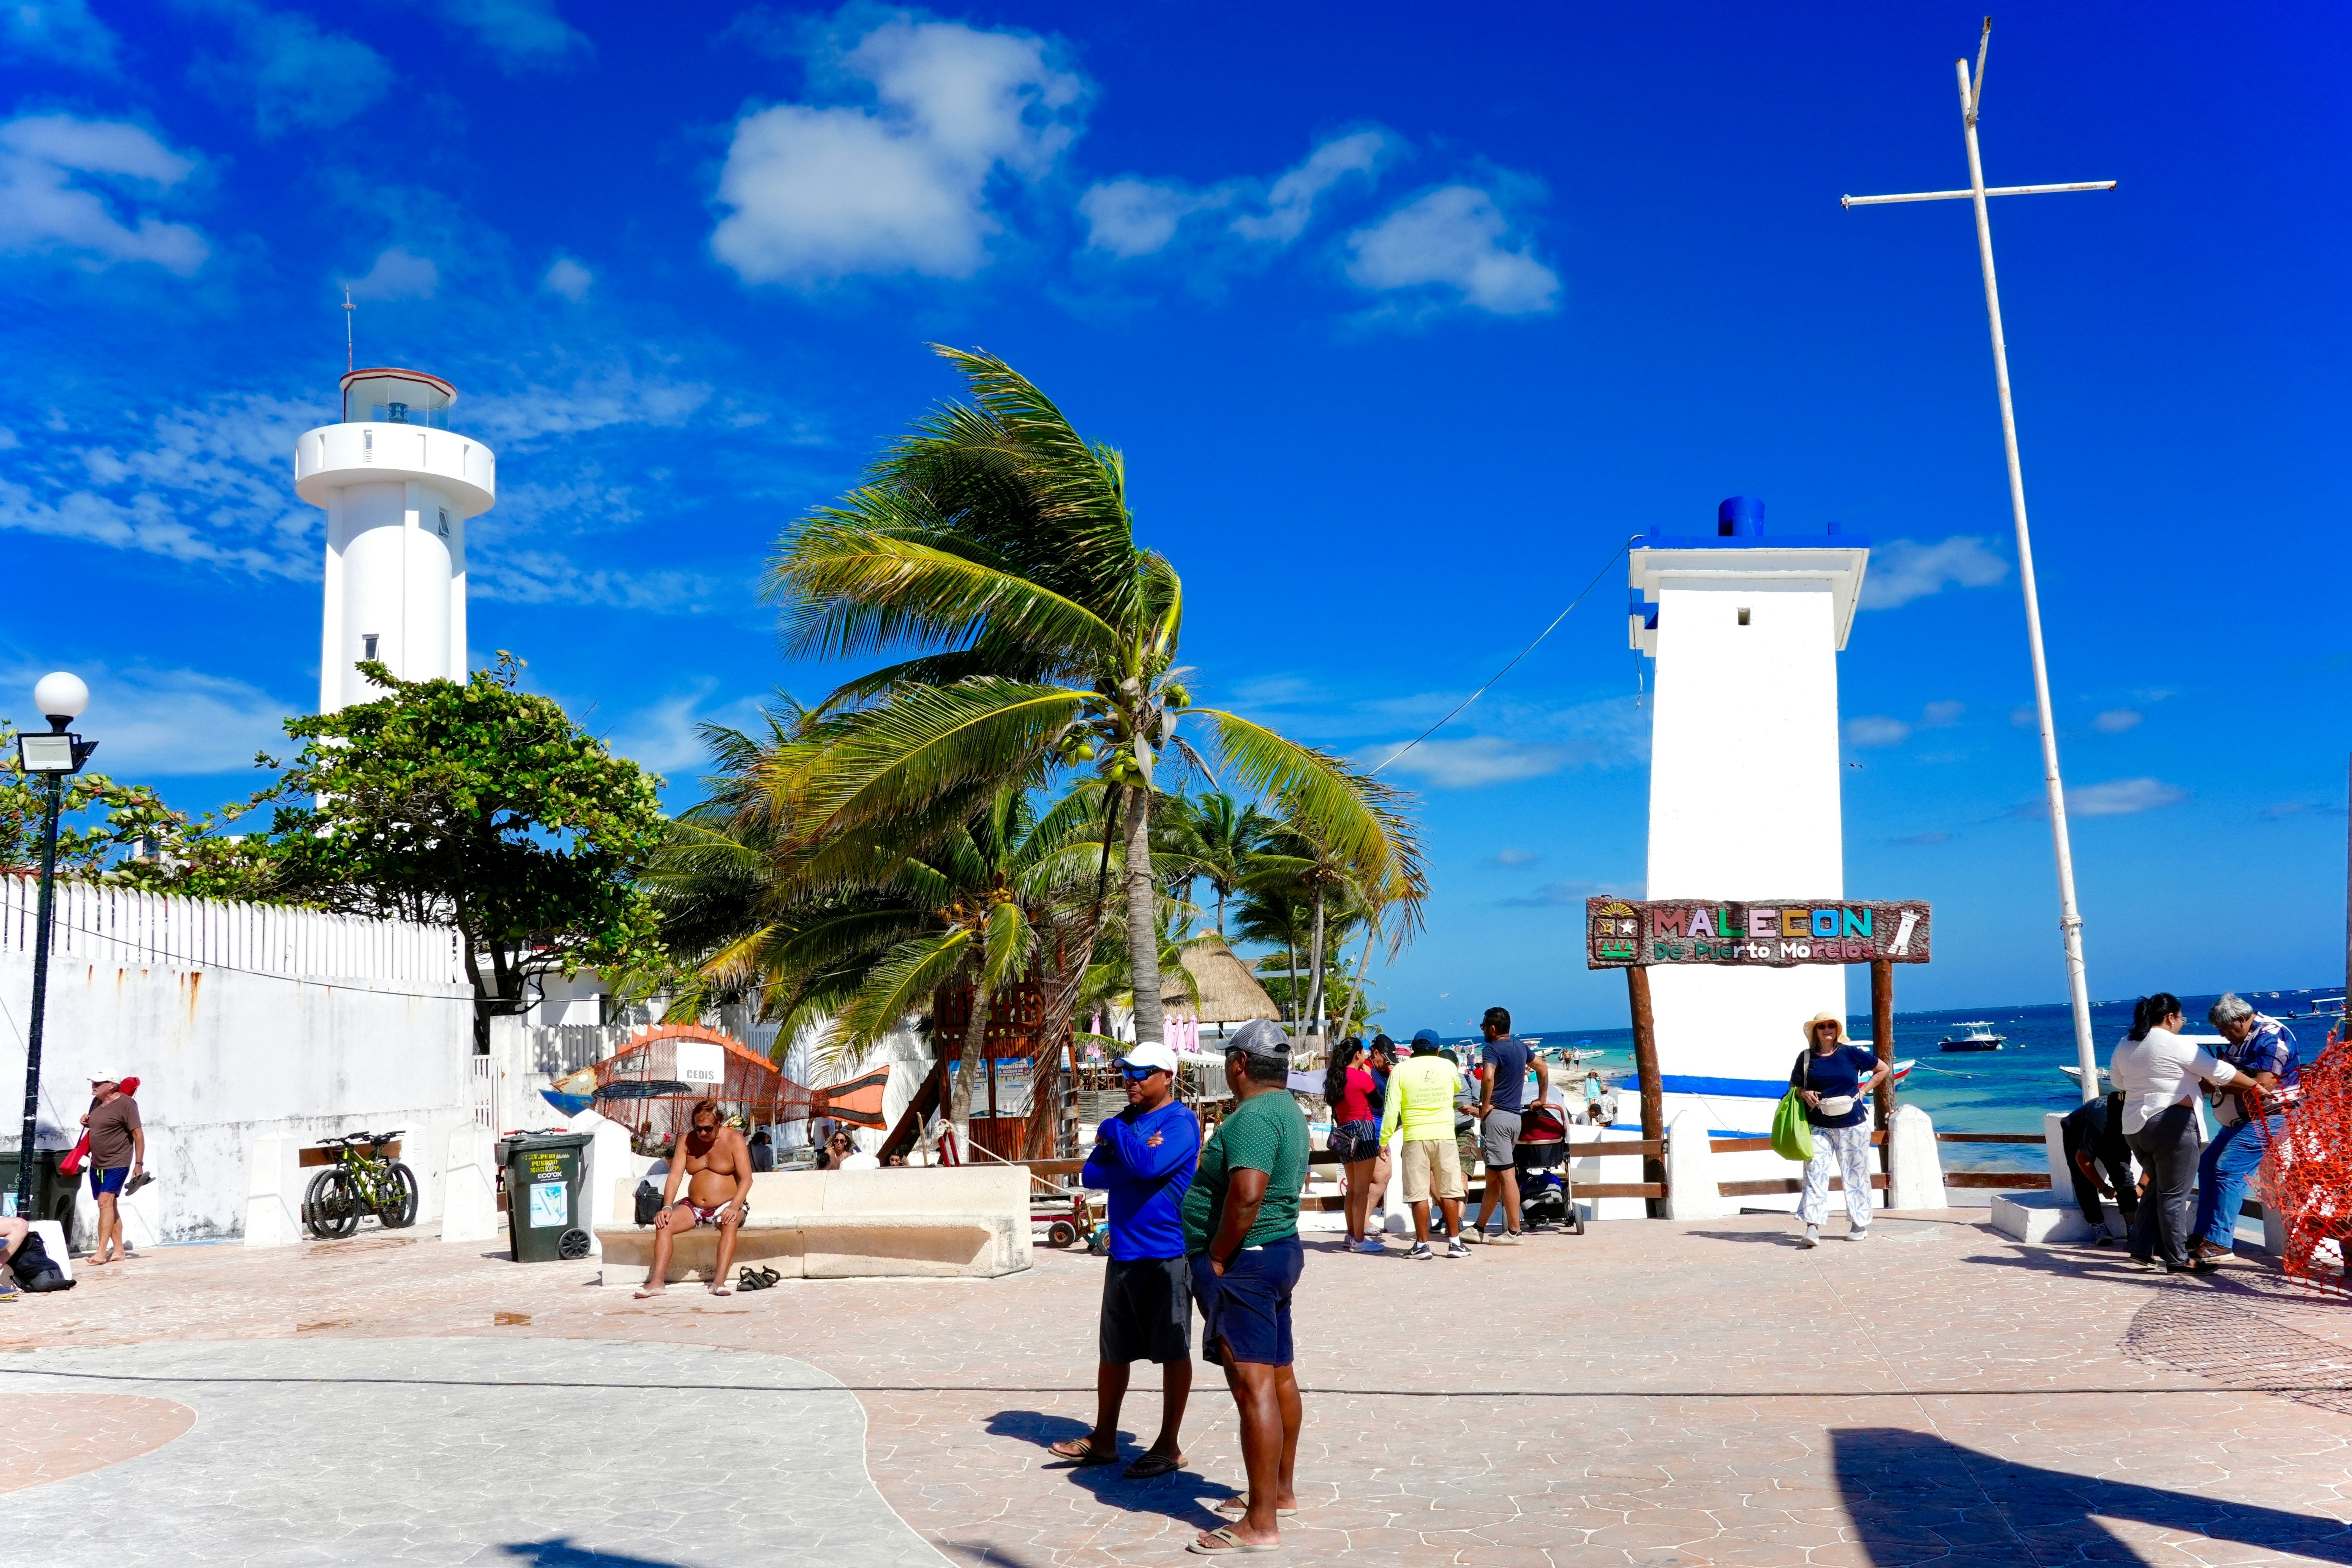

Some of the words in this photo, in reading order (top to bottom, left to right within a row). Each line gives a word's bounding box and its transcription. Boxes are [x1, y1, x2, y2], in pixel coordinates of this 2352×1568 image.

[1653, 909, 1872, 937] MALECON
[1655, 942, 1683, 960] De
[1695, 941, 1770, 959] Puerto
[1780, 940, 1874, 958] Morelos
[687, 1070, 714, 1080] CEDIS
